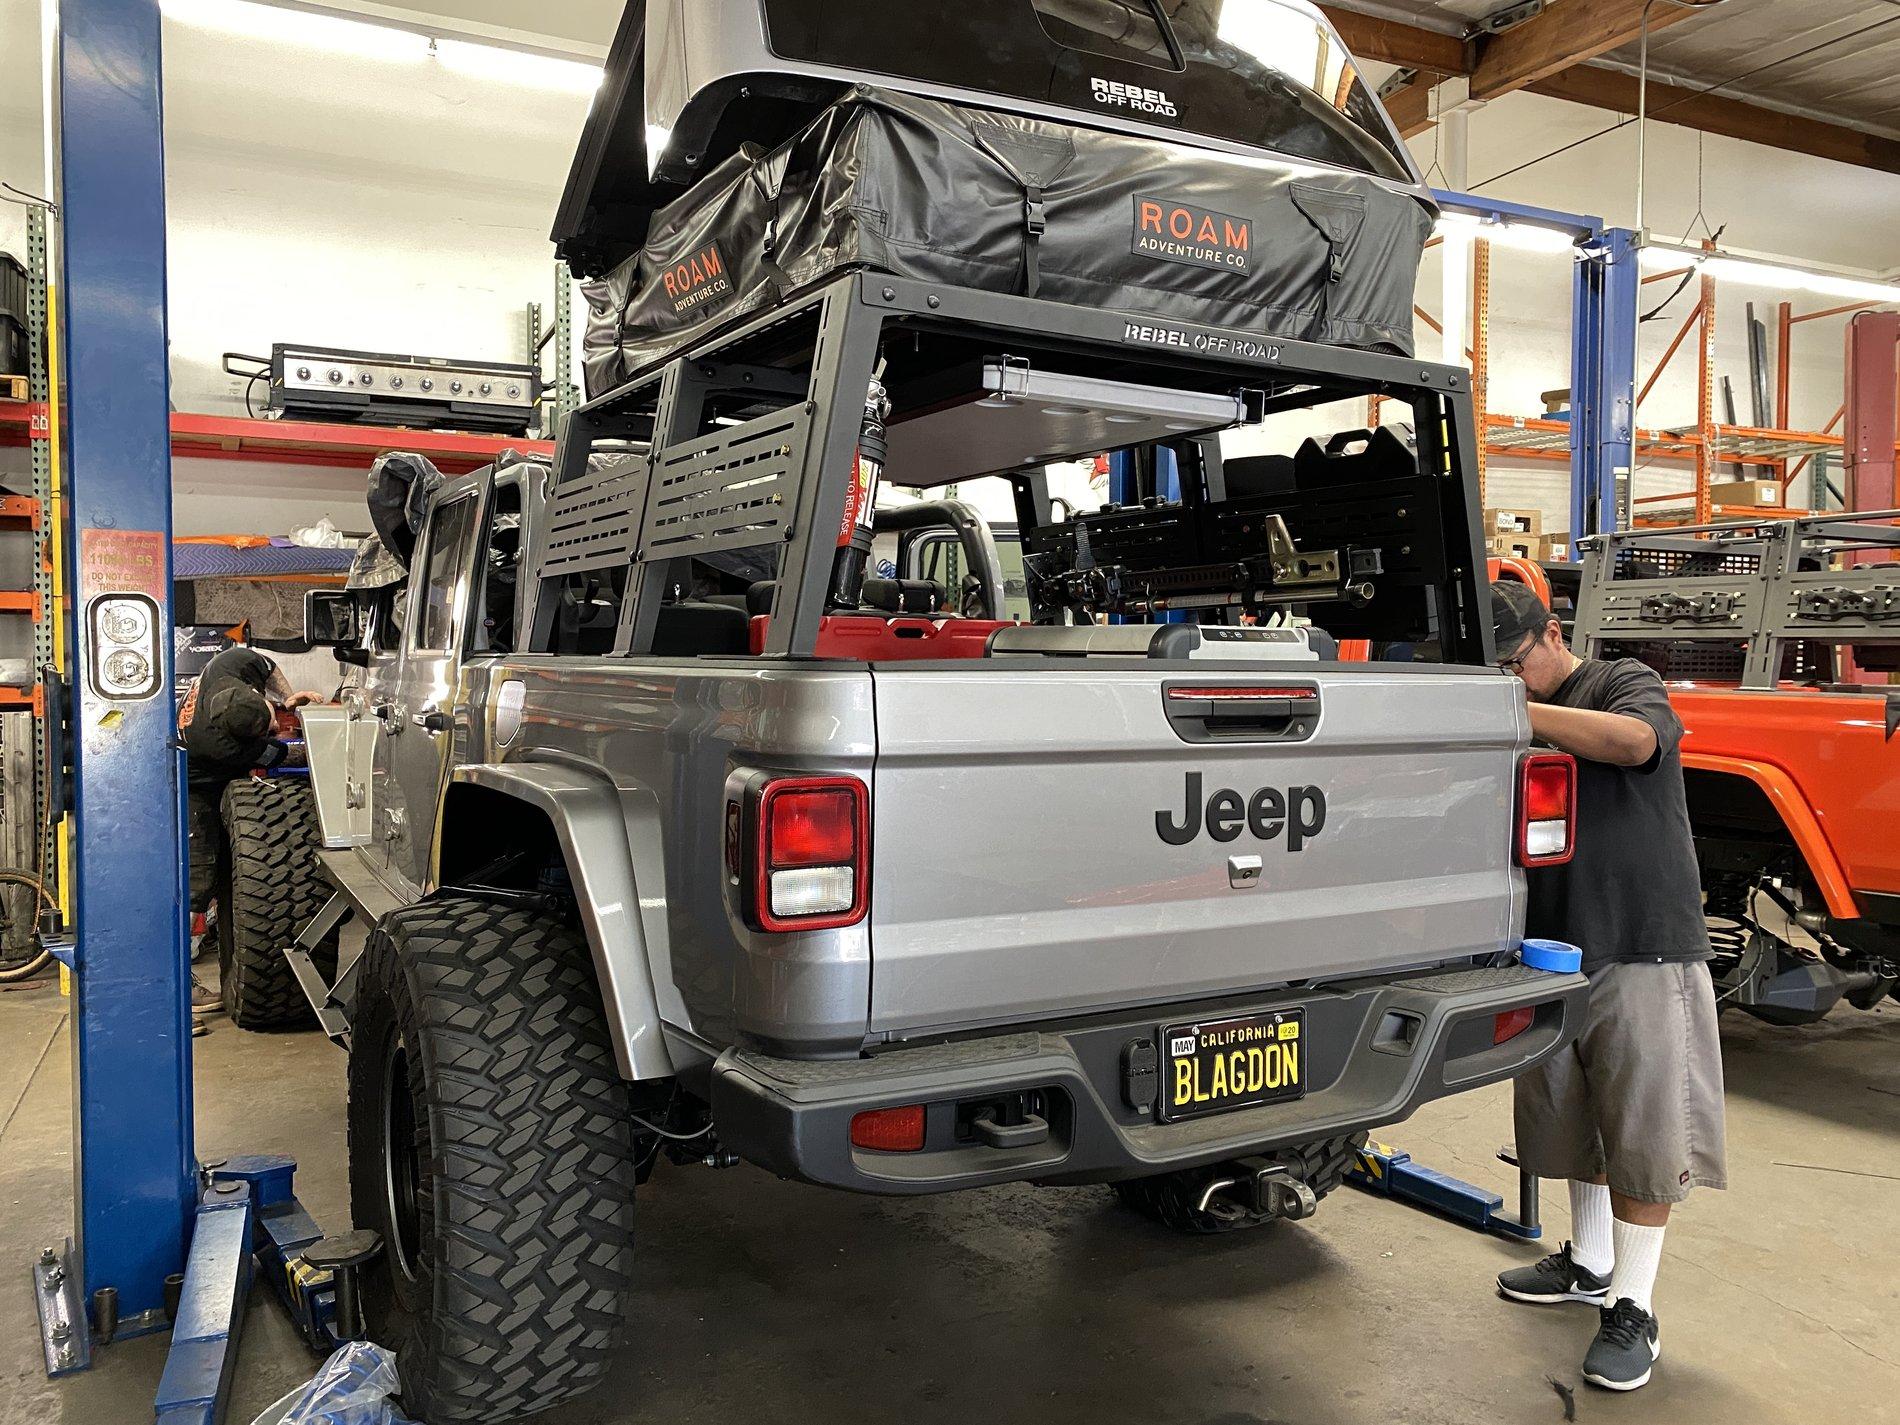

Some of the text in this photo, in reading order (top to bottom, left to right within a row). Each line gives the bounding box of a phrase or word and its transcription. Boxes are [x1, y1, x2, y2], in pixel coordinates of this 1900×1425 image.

[1090, 77, 1174, 107] REBEL
[1093, 91, 1178, 117] OFF ROAD
[1141, 202, 1248, 251] ROAM
[1139, 236, 1246, 269] ADVENTURE CO.
[664, 247, 722, 299] ROAM
[674, 279, 729, 313] ADVENTURE CO.
[1124, 323, 1280, 360] REBEL OFF ROAD
[847, 479, 856, 493] TO
[840, 495, 855, 536] RELEASE
[91, 572, 103, 580] DO
[105, 573, 121, 581] NOT
[99, 583, 117, 591] THIS
[1155, 771, 1327, 852] Jeep
[1174, 1039, 1195, 1054] MAY
[1201, 1024, 1275, 1048] CALIFORNIA
[1173, 1041, 1299, 1106] BLAGDON
